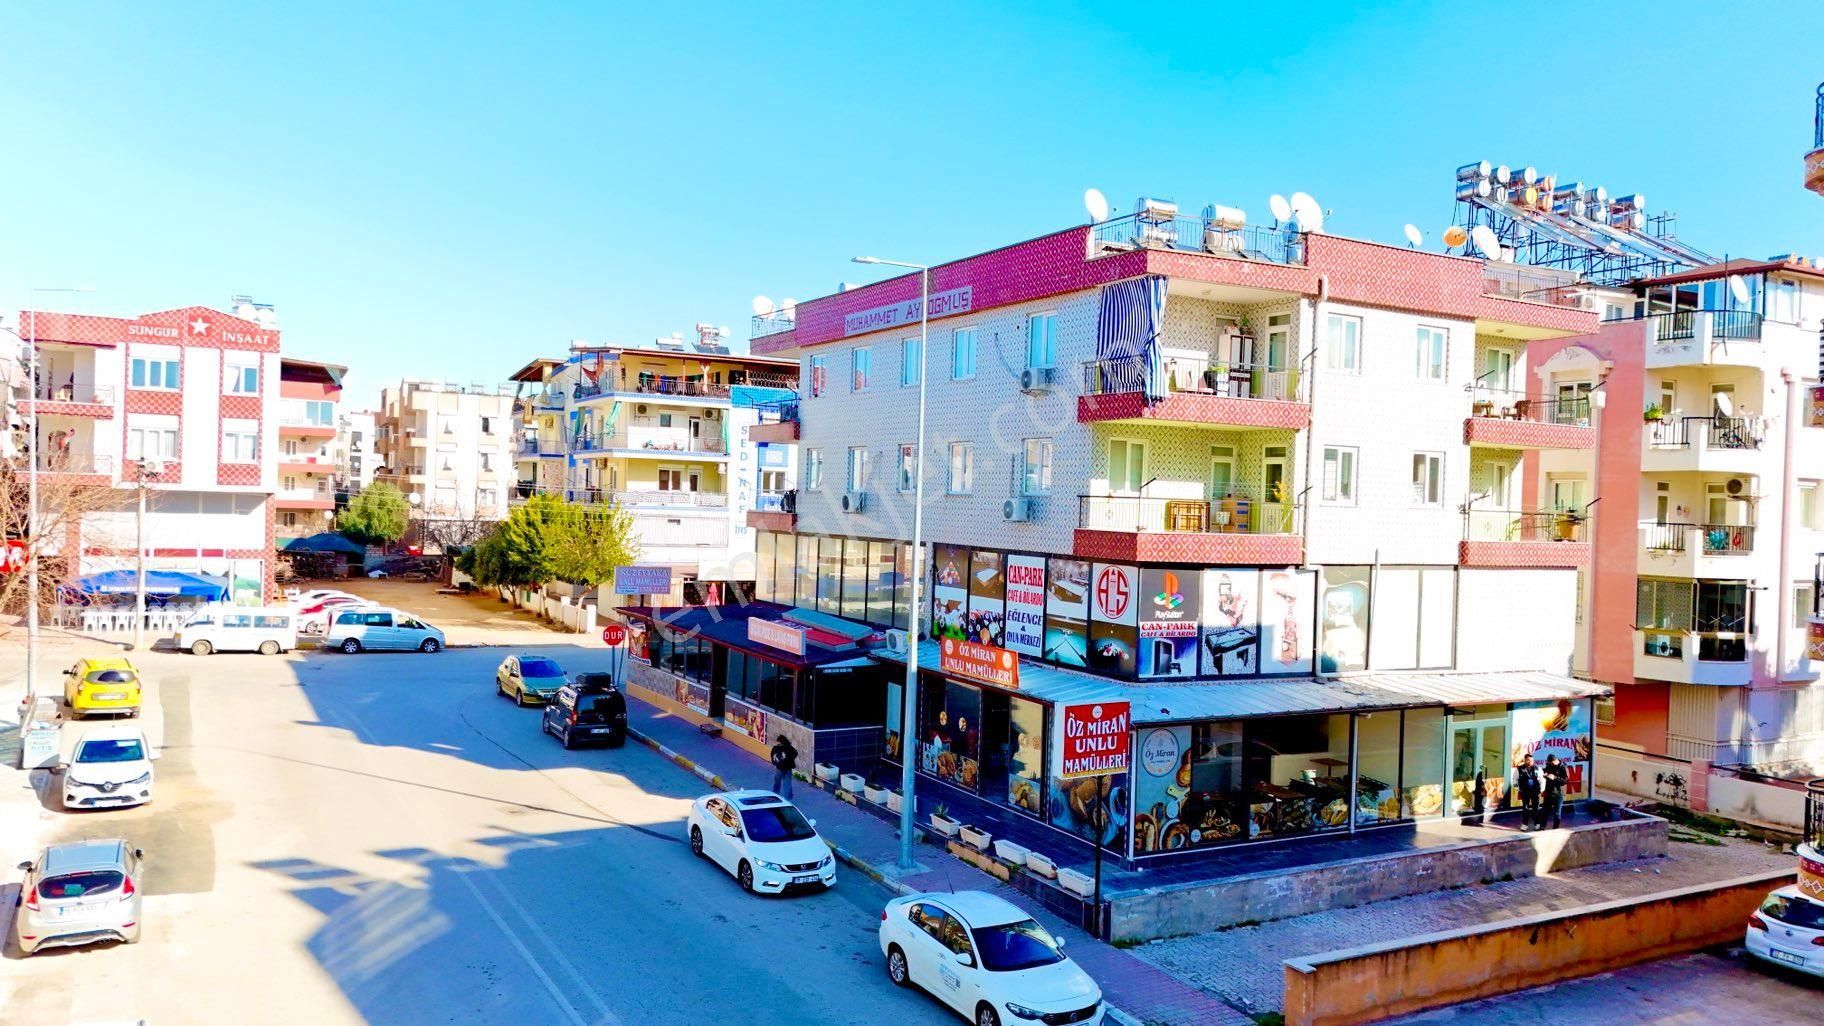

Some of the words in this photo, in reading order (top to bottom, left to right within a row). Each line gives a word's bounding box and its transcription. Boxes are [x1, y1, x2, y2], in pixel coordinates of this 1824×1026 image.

[846, 308, 899, 332] MUHAMMET
[128, 325, 180, 338] SUNGUR
[223, 331, 269, 345] İNŞAAT
[1008, 564, 1044, 587] CAN-PARK
[1007, 609, 1042, 626] EĞLENCE
[1141, 622, 1196, 631] CAN-PARK
[604, 631, 623, 640] DUR
[1020, 634, 1042, 648] MERKEZİ
[959, 642, 970, 657] ÖZ
[971, 646, 996, 663] MİRAN
[945, 657, 965, 671] UNLU
[965, 662, 1013, 683] MAMÜLLERİ
[1067, 712, 1084, 738] ÖZ
[1087, 711, 1126, 736] MİRAN
[1075, 736, 1117, 753] UNLU
[1544, 737, 1577, 750] MİRAN
[1065, 749, 1126, 774] MAMÜLLERİ
